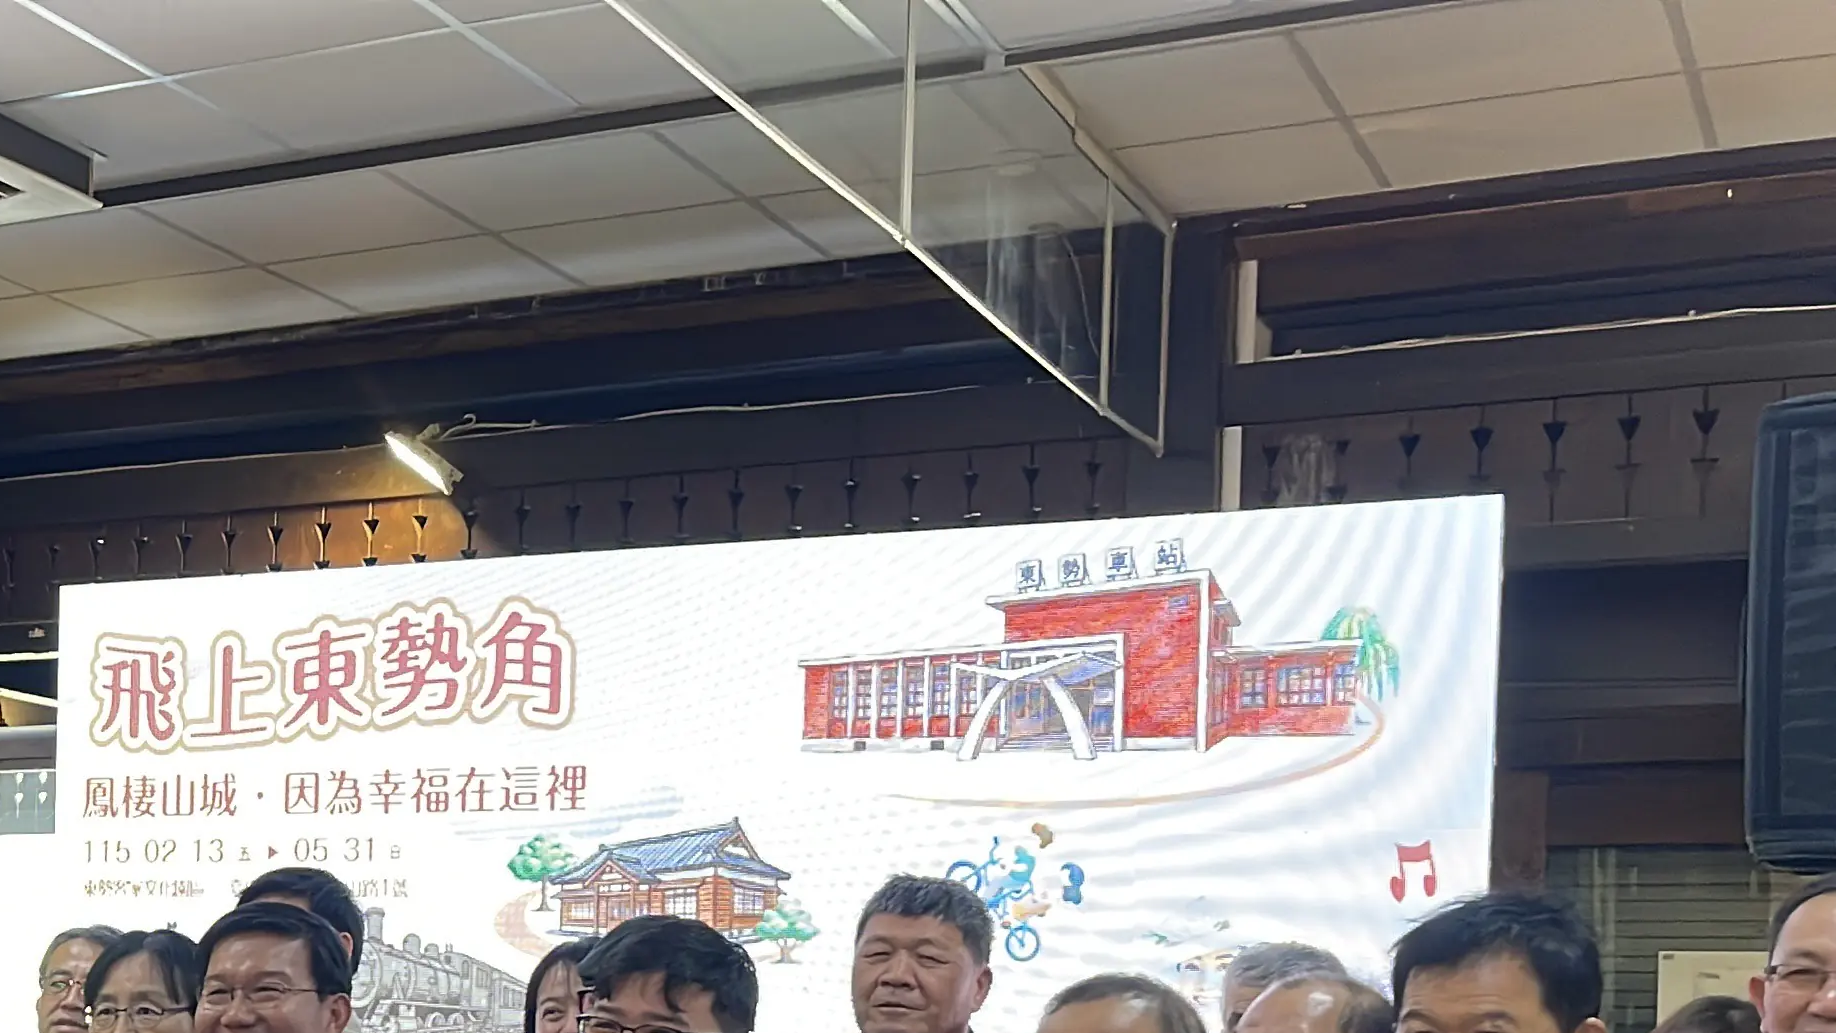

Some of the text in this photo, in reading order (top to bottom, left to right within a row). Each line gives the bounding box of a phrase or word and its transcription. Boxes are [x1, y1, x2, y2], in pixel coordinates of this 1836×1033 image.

[1018, 540, 1183, 586] 東勢車站
[96, 601, 573, 749] 飛上東勢角
[83, 838, 131, 865] 115
[194, 837, 225, 863] 13
[343, 837, 375, 862] 31
